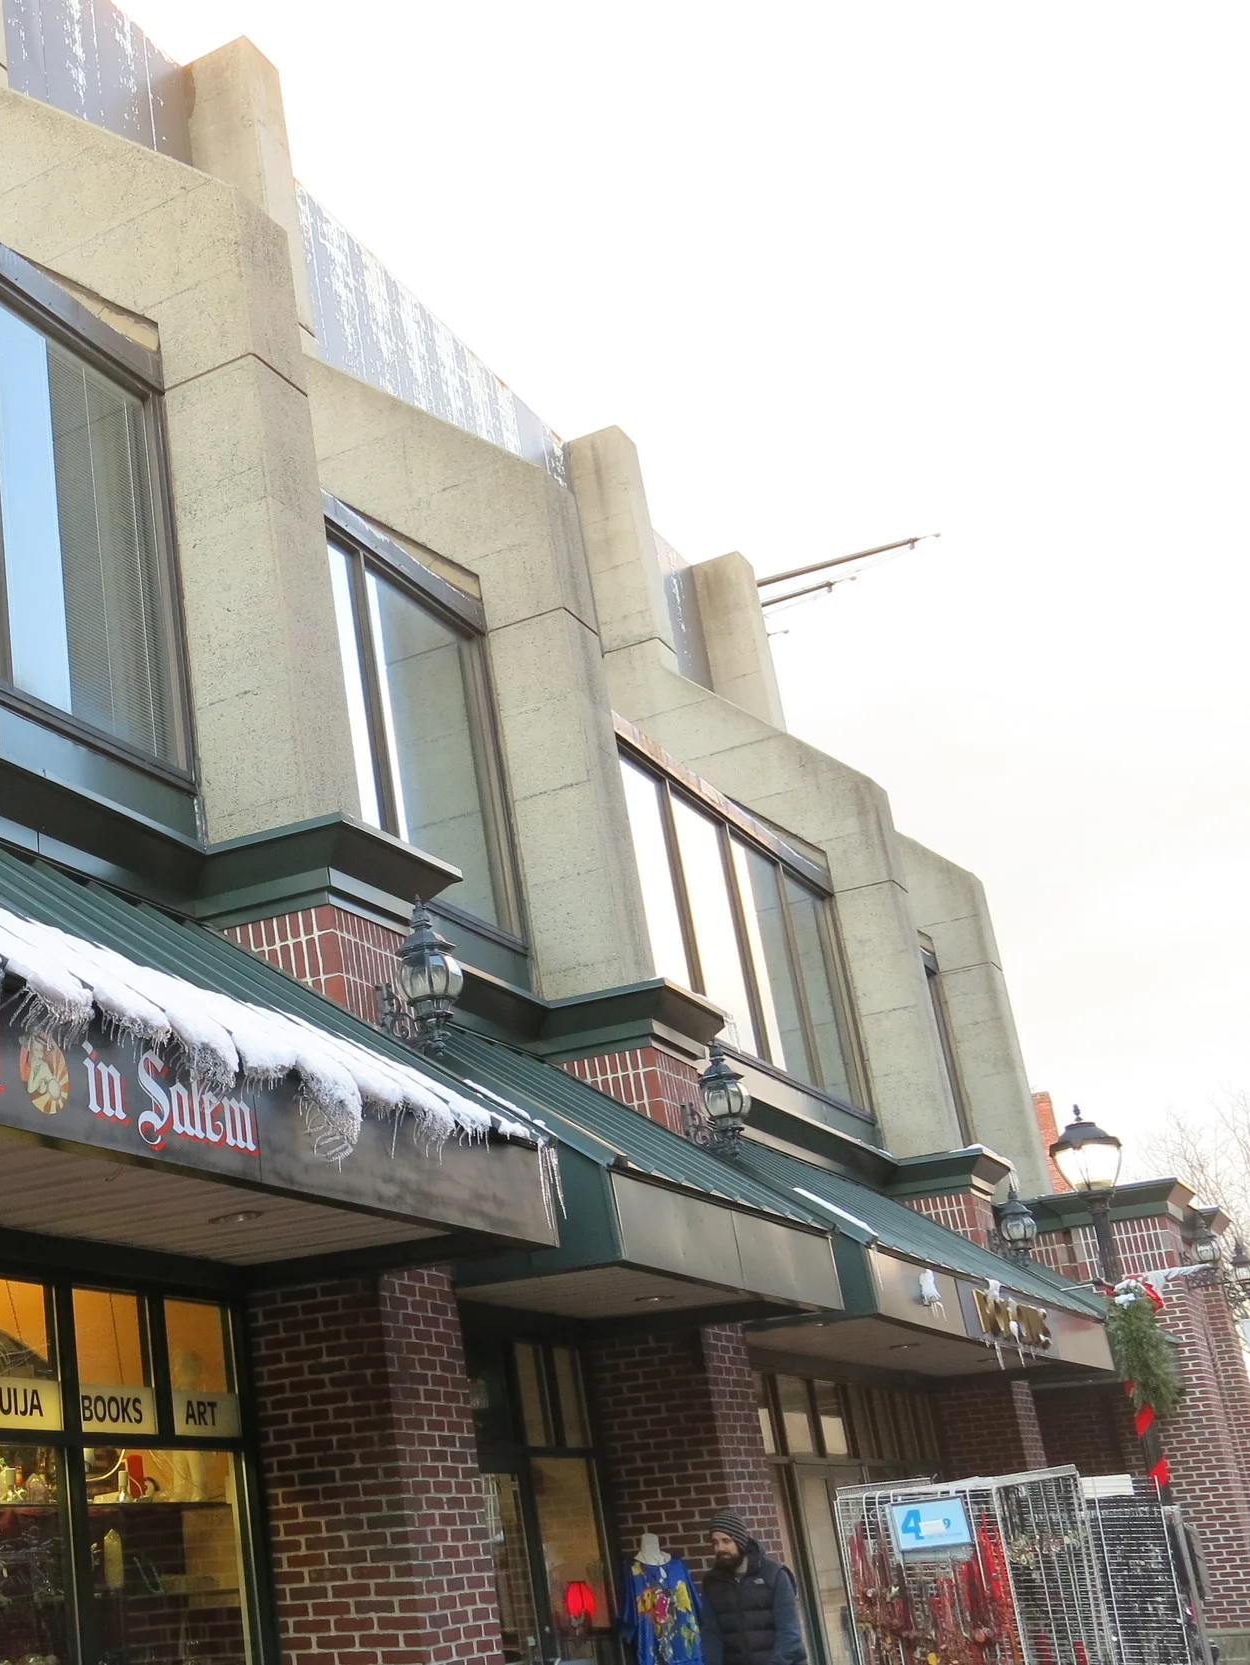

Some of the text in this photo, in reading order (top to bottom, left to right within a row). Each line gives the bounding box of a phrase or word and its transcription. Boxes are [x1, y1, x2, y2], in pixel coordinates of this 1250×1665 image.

[82, 1040, 131, 1125] in
[138, 1051, 259, 1156] Salem
[82, 1394, 143, 1425] BOOKS
[185, 1400, 217, 1427] ART
